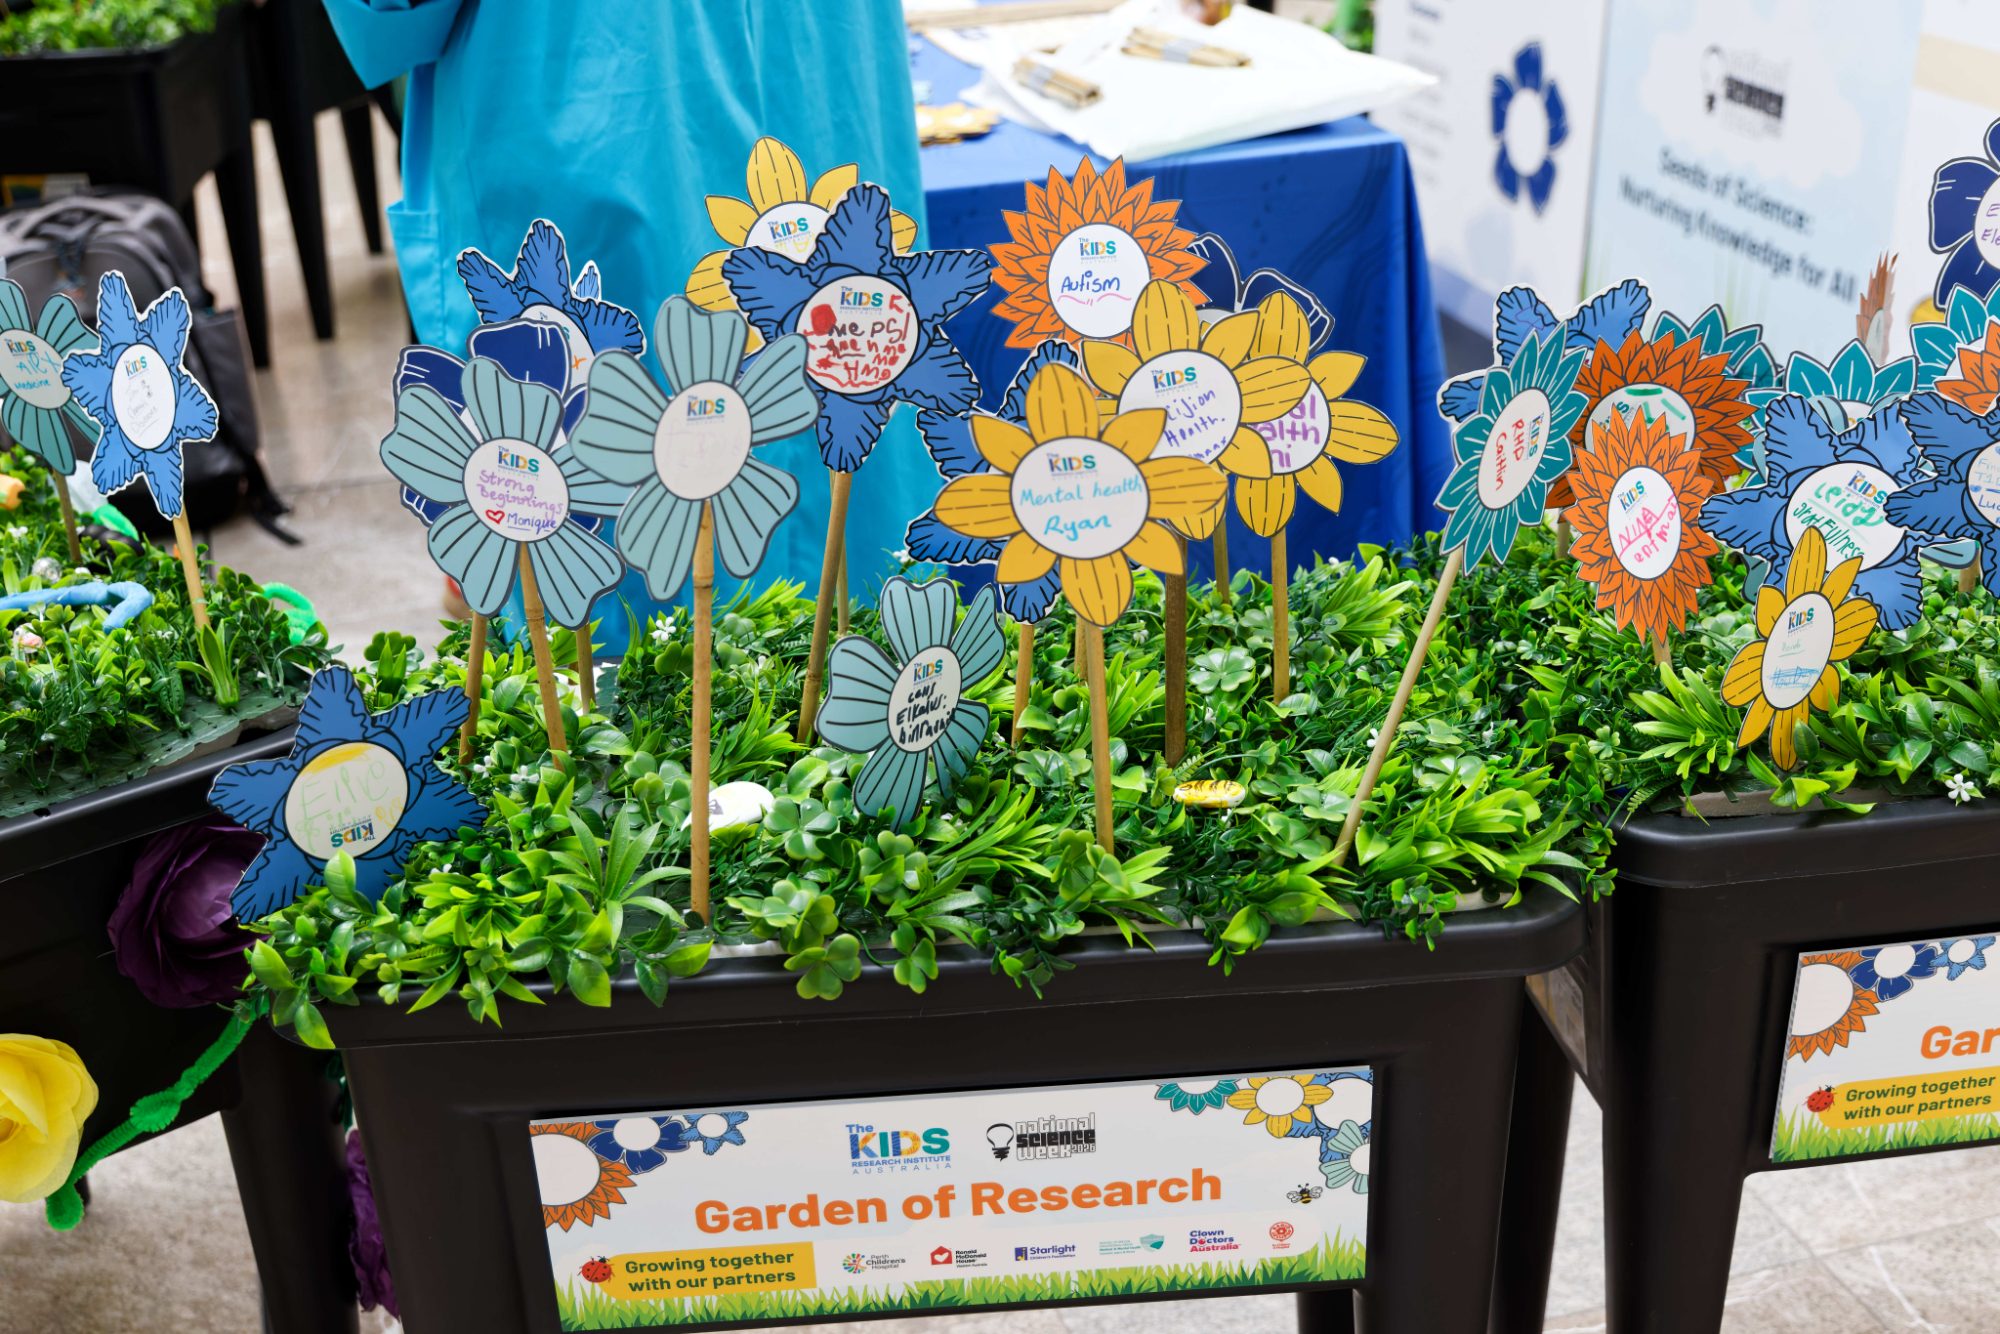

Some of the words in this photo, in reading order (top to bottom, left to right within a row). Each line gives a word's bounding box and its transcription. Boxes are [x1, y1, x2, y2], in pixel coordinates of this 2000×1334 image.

[770, 217, 809, 240] KIDS
[1080, 240, 1117, 256] KIDS
[1060, 270, 1120, 293] Autism
[840, 291, 884, 307] KIDS
[7, 340, 36, 353] KIDS
[125, 355, 148, 377] KIDS
[1153, 366, 1197, 390] KIDS
[687, 398, 726, 416] KIDS
[1529, 414, 1542, 457] KIDS
[498, 451, 540, 472] KIDS
[1049, 455, 1096, 472] KIDS
[479, 469, 535, 501] Strong
[1020, 484, 1083, 506] Mental
[1093, 474, 1142, 498] health
[1620, 480, 1645, 511] KIDS
[1848, 475, 1887, 505] KIDS
[507, 512, 557, 535] Monique
[1044, 515, 1112, 541] Ryan
[1788, 607, 1814, 630] KIDS
[914, 658, 943, 682] KIDS
[331, 822, 375, 848] KIDS
[1920, 1025, 2000, 1060] Gar
[1846, 1083, 1917, 1103] Growing
[1921, 1075, 1996, 1096] together
[1843, 1104, 1881, 1121] with
[1885, 1102, 1914, 1117] our
[1917, 1094, 1992, 1116] partners
[845, 1123, 874, 1133] The
[1016, 1112, 1095, 1134] national
[849, 1127, 950, 1160] KIDS
[1016, 1129, 1096, 1148] science
[851, 1158, 901, 1168] RESEARCH
[903, 1155, 951, 1165] INSTITUTE
[1017, 1144, 1072, 1161] week
[852, 1163, 952, 1175] AUSTRALIA
[695, 1193, 887, 1234] Garden
[902, 1184, 957, 1220] of
[971, 1168, 1222, 1216] Research
[1190, 1229, 1224, 1238] Clown
[1190, 1236, 1235, 1245] Doctors
[1030, 1244, 1076, 1255] Starlight
[1190, 1243, 1240, 1253] Australia
[625, 1256, 705, 1275] Growing
[710, 1251, 795, 1270] together
[866, 1258, 906, 1266] Children's
[628, 1274, 672, 1292] with
[676, 1275, 706, 1289] our
[712, 1270, 797, 1290] partners
